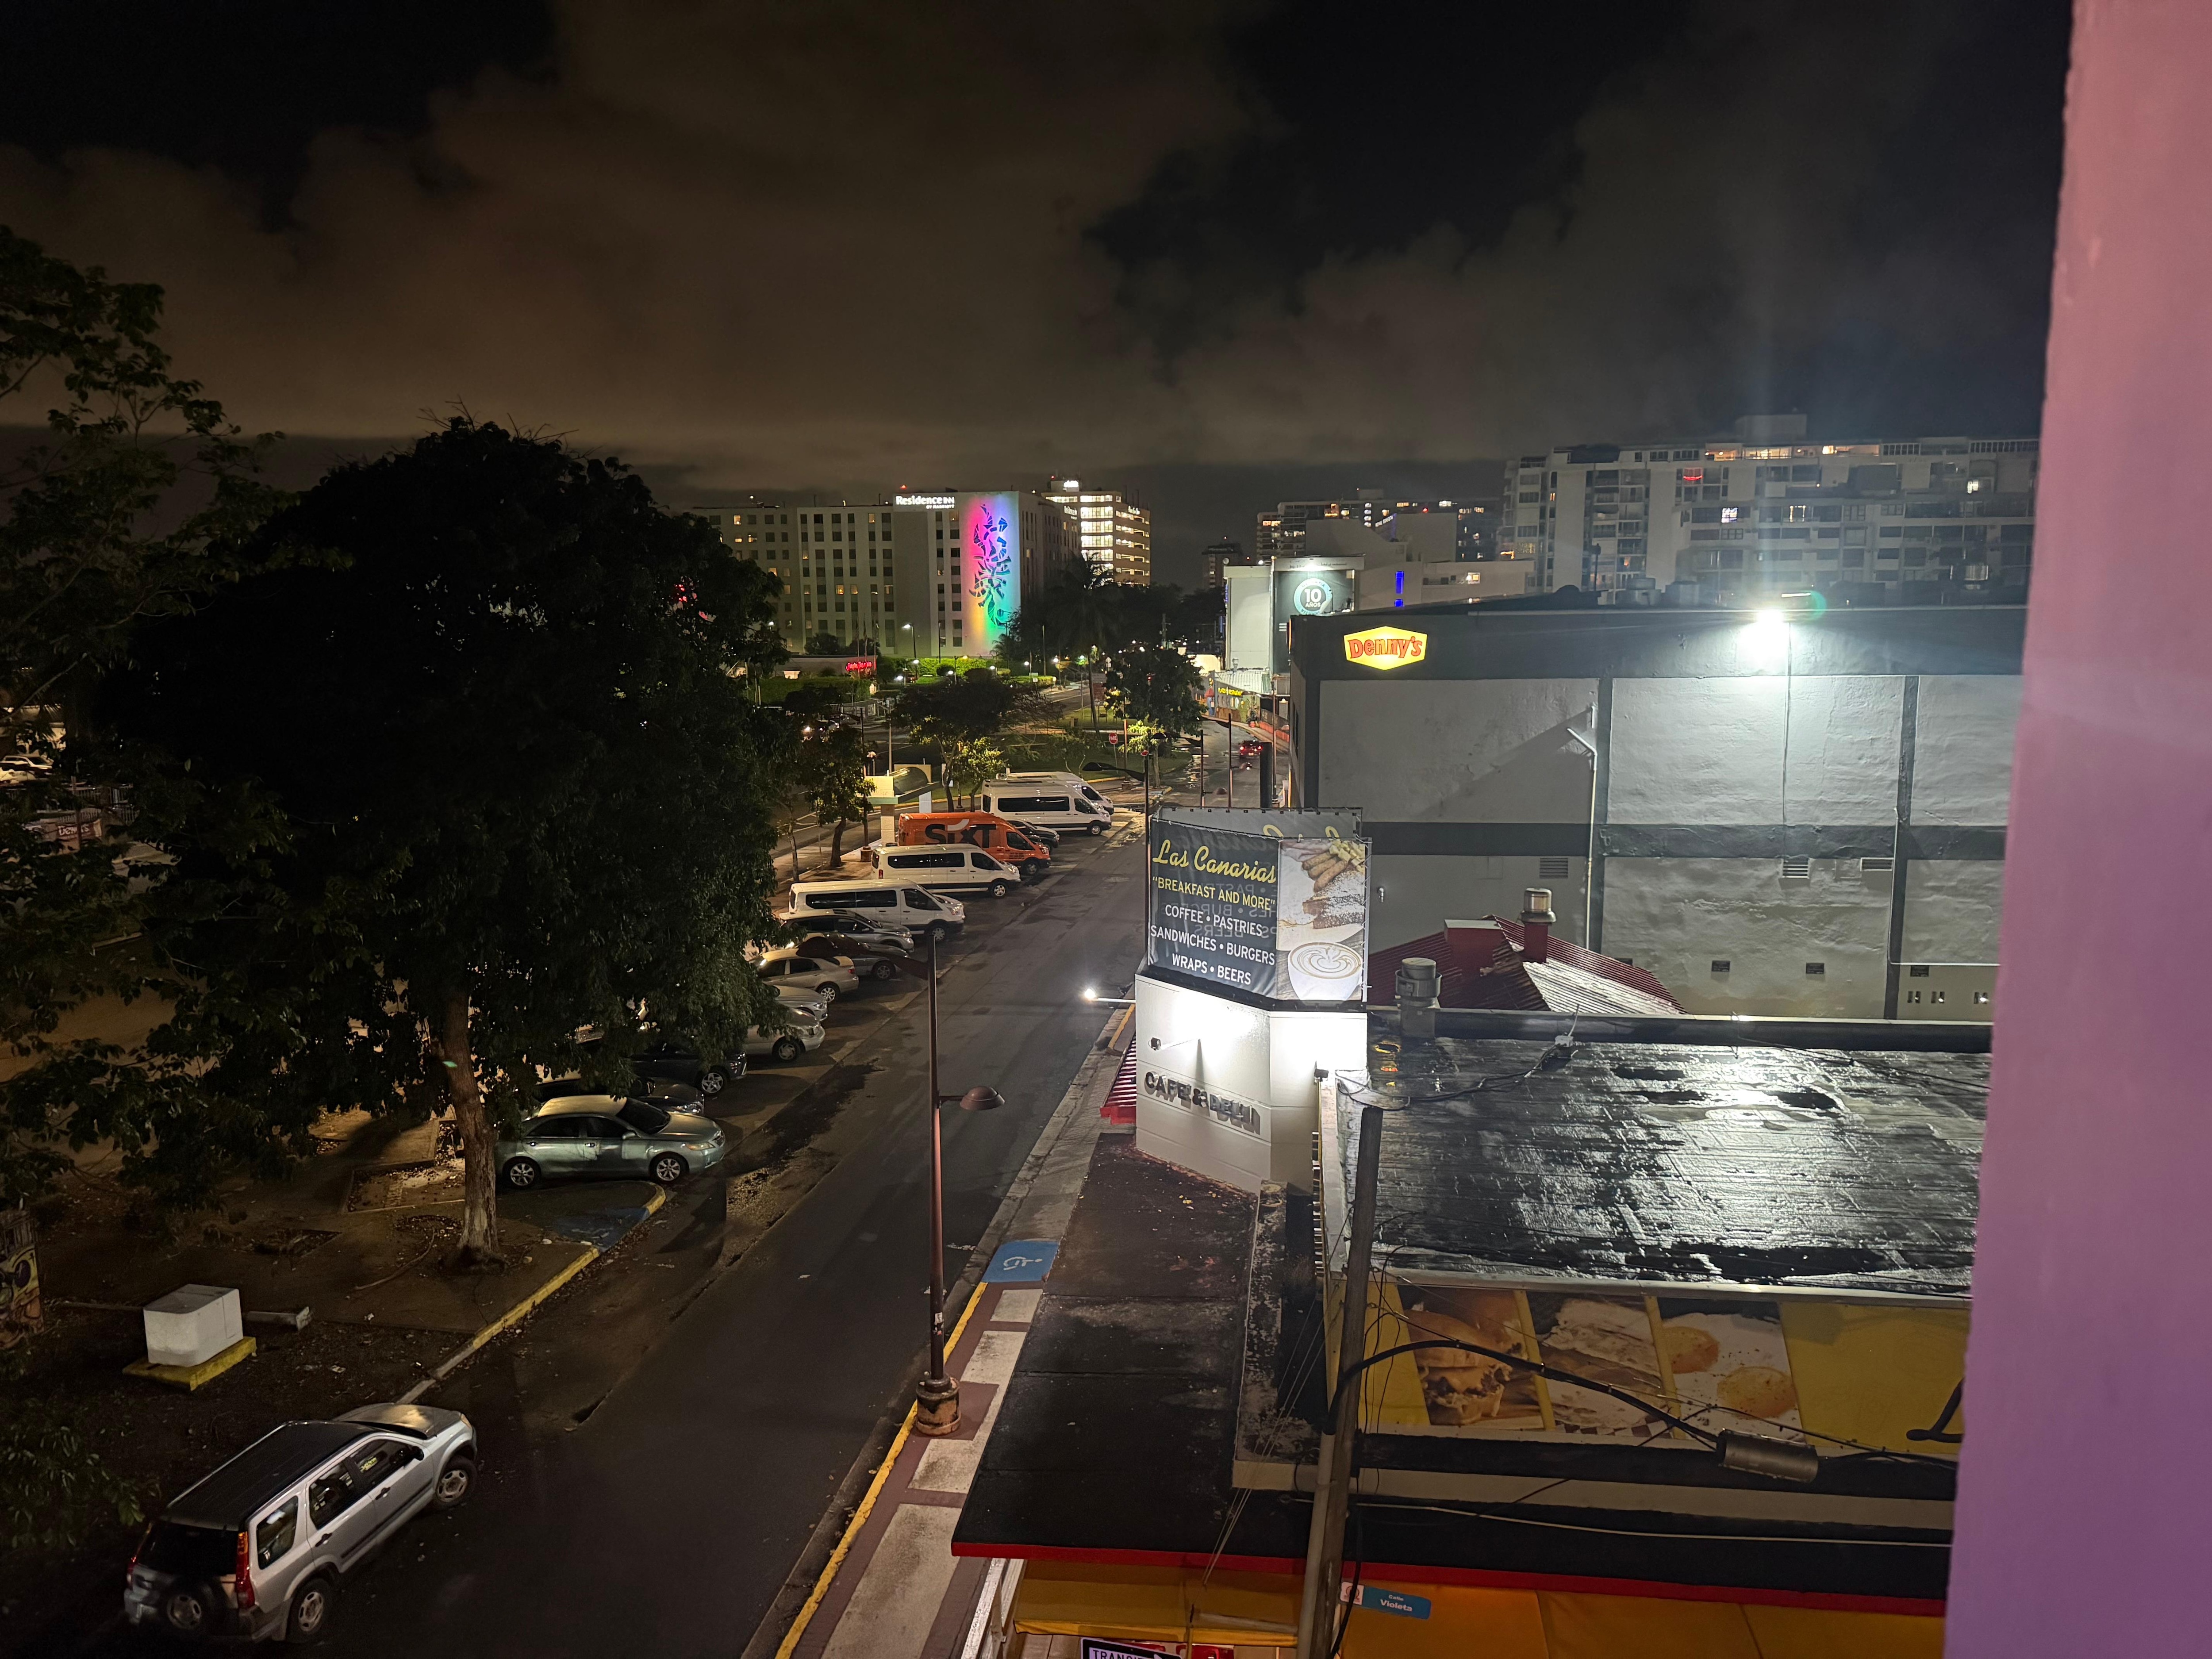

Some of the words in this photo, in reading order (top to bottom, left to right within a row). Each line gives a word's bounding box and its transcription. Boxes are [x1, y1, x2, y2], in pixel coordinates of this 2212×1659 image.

[896, 495, 942, 505] Residence
[1304, 588, 1322, 603] 10
[1348, 636, 1422, 659] Denny's
[1152, 839, 1189, 867] Las
[1194, 845, 1276, 883] Canarias
[1152, 876, 1216, 899] "BREAKFAST
[1218, 889, 1240, 904] AND
[1242, 893, 1275, 910] MORE"
[1165, 904, 1204, 924] COFFEE
[1214, 914, 1262, 937] PASTRIES
[1151, 925, 1217, 951] SANDWICHES
[1226, 942, 1275, 966] BURGERS
[1172, 953, 1208, 974] WRAPS
[1217, 965, 1251, 985] BEERS
[1380, 1598, 1413, 1612] Violeta
